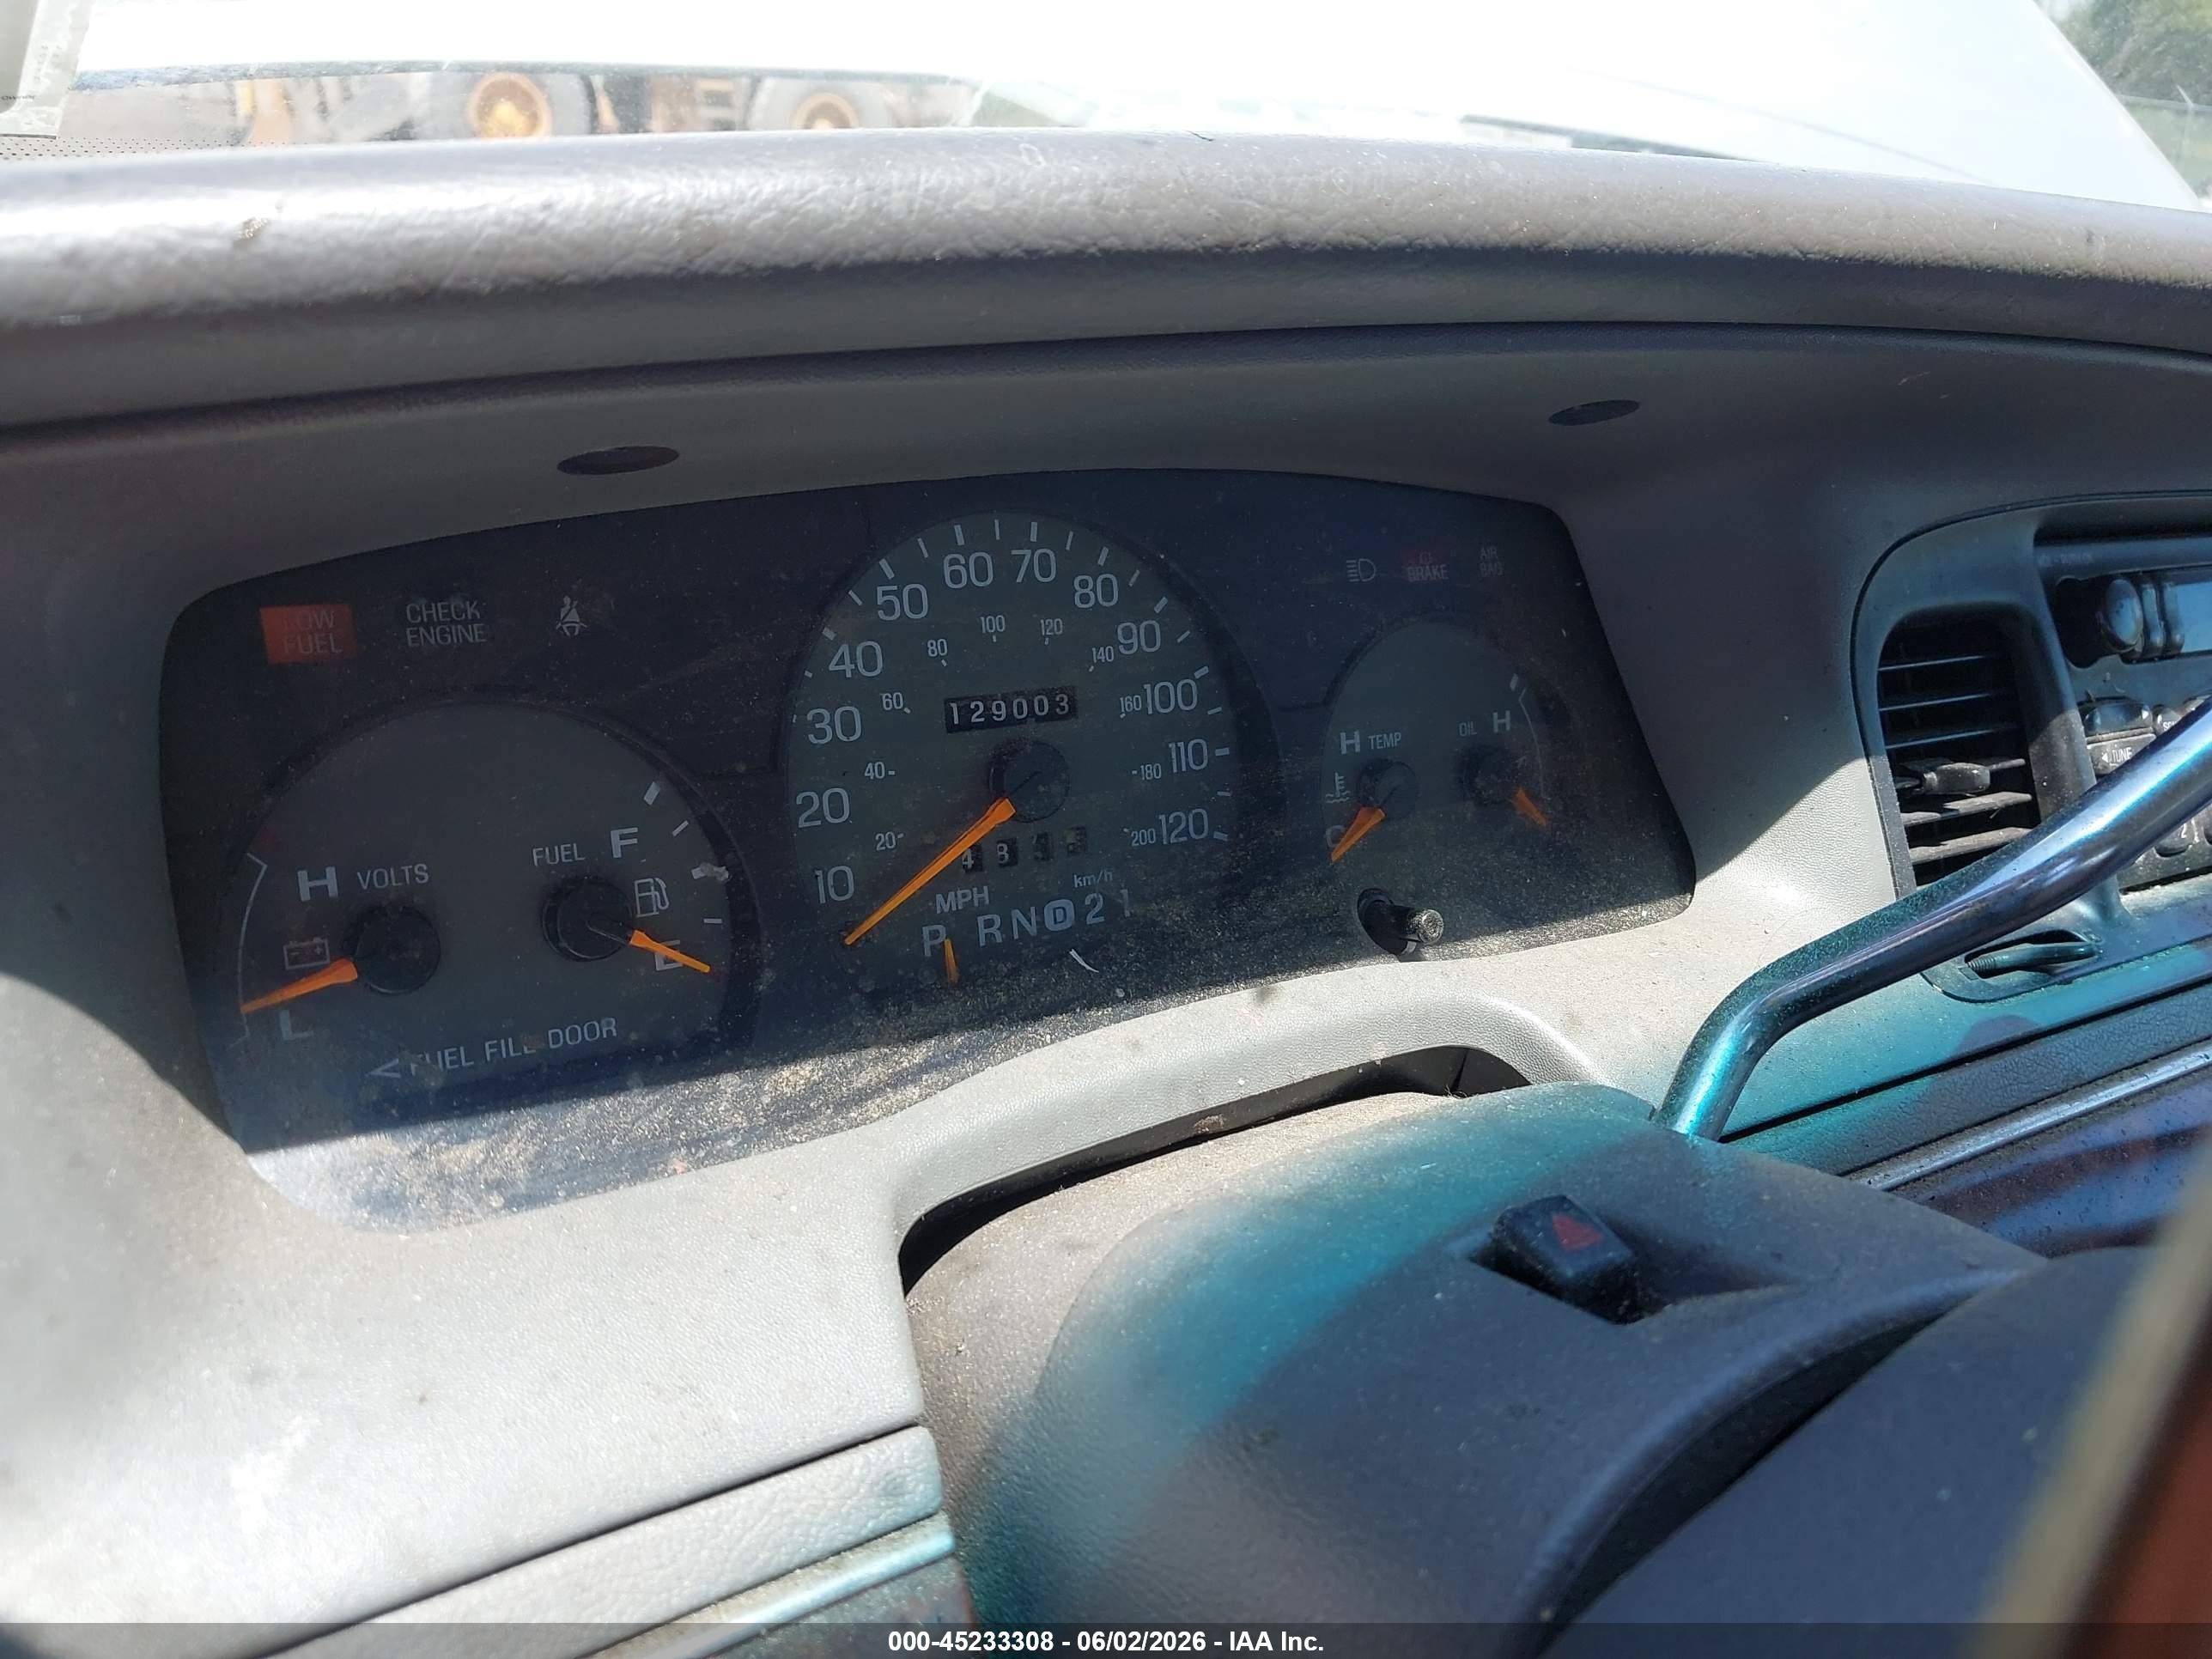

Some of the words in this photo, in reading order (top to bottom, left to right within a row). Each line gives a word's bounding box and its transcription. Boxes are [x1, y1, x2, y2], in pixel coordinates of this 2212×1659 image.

[944, 551, 994, 589] 60
[1011, 548, 1057, 583] 70
[1407, 563, 1449, 583] BRAKE
[876, 583, 928, 622] 50
[1073, 573, 1120, 609] 80
[283, 610, 337, 631] LOW
[405, 599, 481, 623] CHECK
[980, 615, 1006, 634] 100
[406, 624, 486, 647] ENGINE
[1040, 617, 1064, 637] 120
[1117, 620, 1162, 655] 90
[283, 633, 343, 654] FUEL
[927, 638, 949, 658] 80
[1091, 645, 1115, 664] 140
[829, 640, 884, 678] 40
[881, 692, 905, 712] 60
[950, 694, 1071, 726] 129003
[1120, 695, 1142, 714] 160
[1146, 678, 1199, 716] 100
[806, 706, 862, 745] 30
[1458, 721, 1478, 738] OIL
[1493, 709, 1511, 733] H
[1168, 738, 1209, 775] 110
[1340, 729, 1361, 756] H
[1367, 732, 1402, 750] TEMP
[864, 762, 887, 781] 40
[1140, 763, 1163, 781] 180
[796, 787, 850, 829] 20
[1130, 828, 1158, 848] 200
[1158, 807, 1210, 844] 120
[532, 842, 586, 867] FUEL
[610, 827, 638, 858] F
[875, 831, 897, 852] 20
[297, 866, 339, 902] H
[356, 864, 430, 891] VOLTS
[814, 865, 855, 904] 10
[1073, 867, 1114, 892] km/h
[934, 885, 990, 915] MPH
[921, 925, 946, 957] P
[977, 914, 1003, 947] R
[1010, 906, 1038, 938] N
[1085, 895, 1105, 926] 2
[279, 1009, 313, 1041] L
[547, 1017, 617, 1049] DOOR
